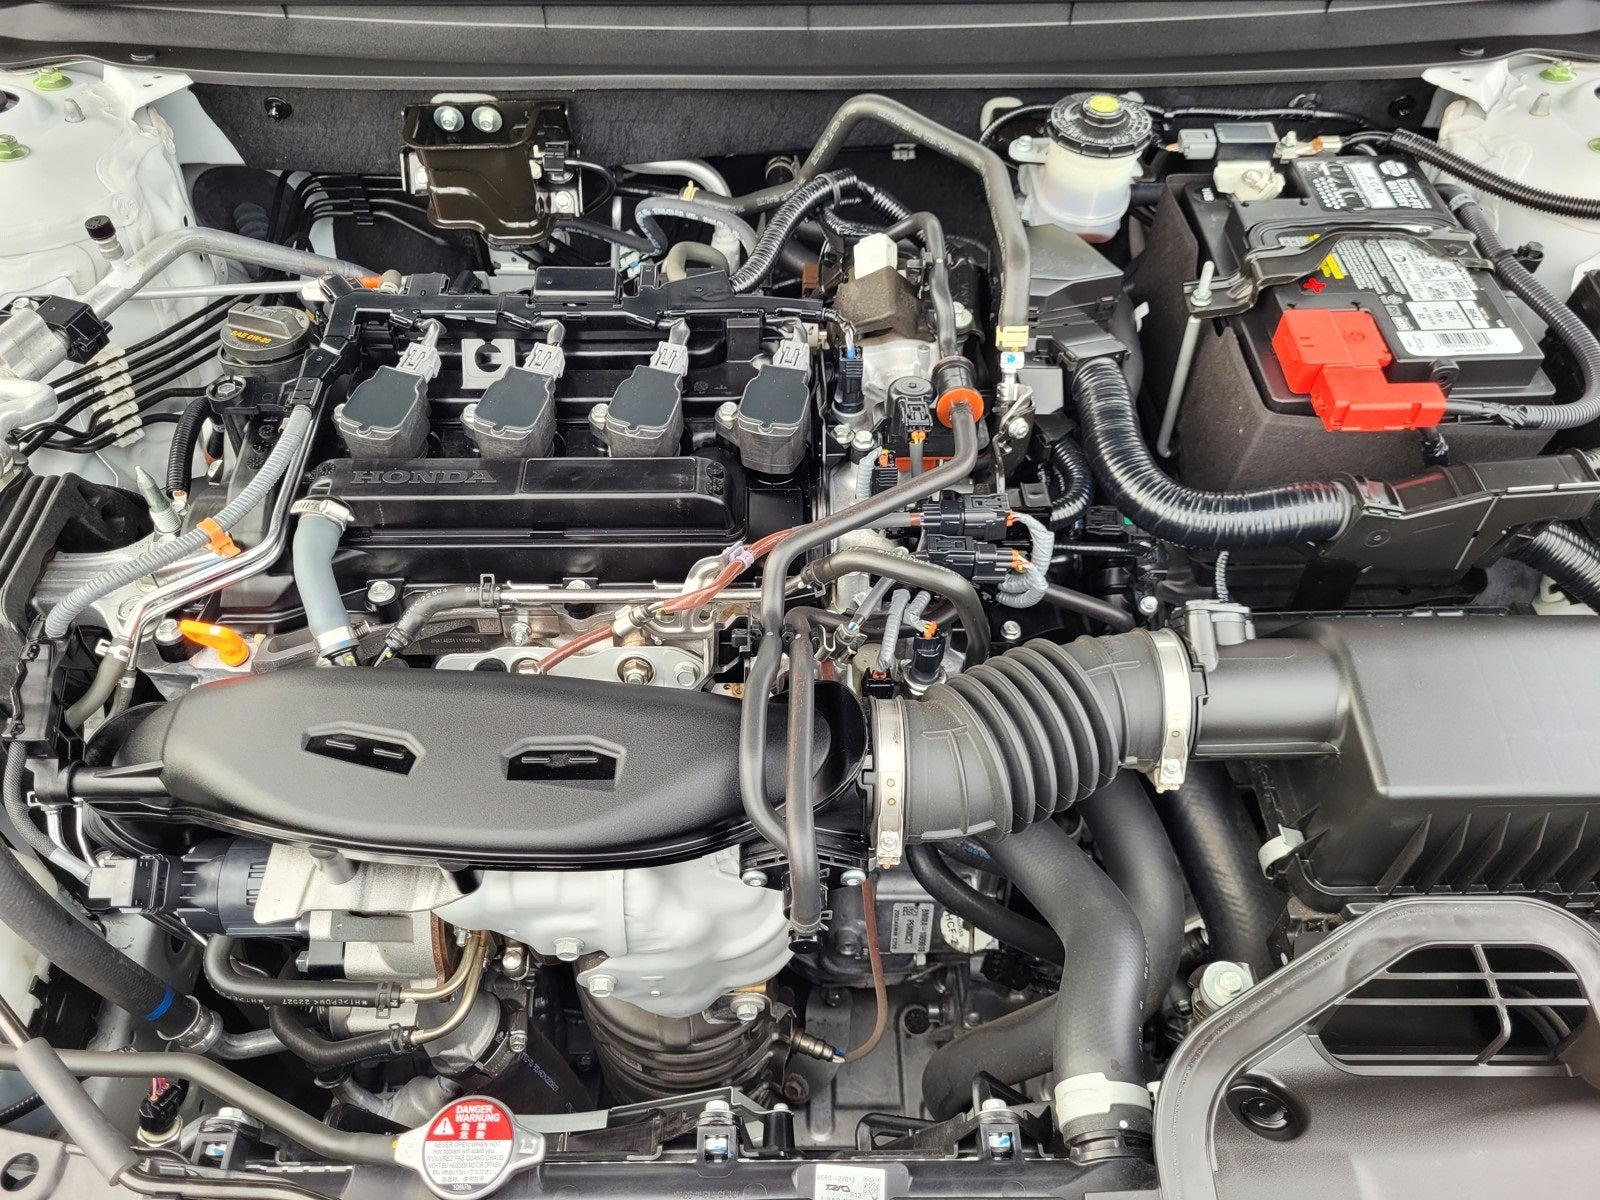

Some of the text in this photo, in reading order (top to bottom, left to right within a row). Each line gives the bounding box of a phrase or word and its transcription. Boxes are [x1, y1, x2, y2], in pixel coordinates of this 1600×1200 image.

[1367, 176, 1384, 194] AGM
[231, 330, 272, 344] SAE 0W-20
[350, 470, 497, 484] HONDA
[456, 1105, 493, 1114] DANGER
[455, 1113, 500, 1122] WARNUNG
